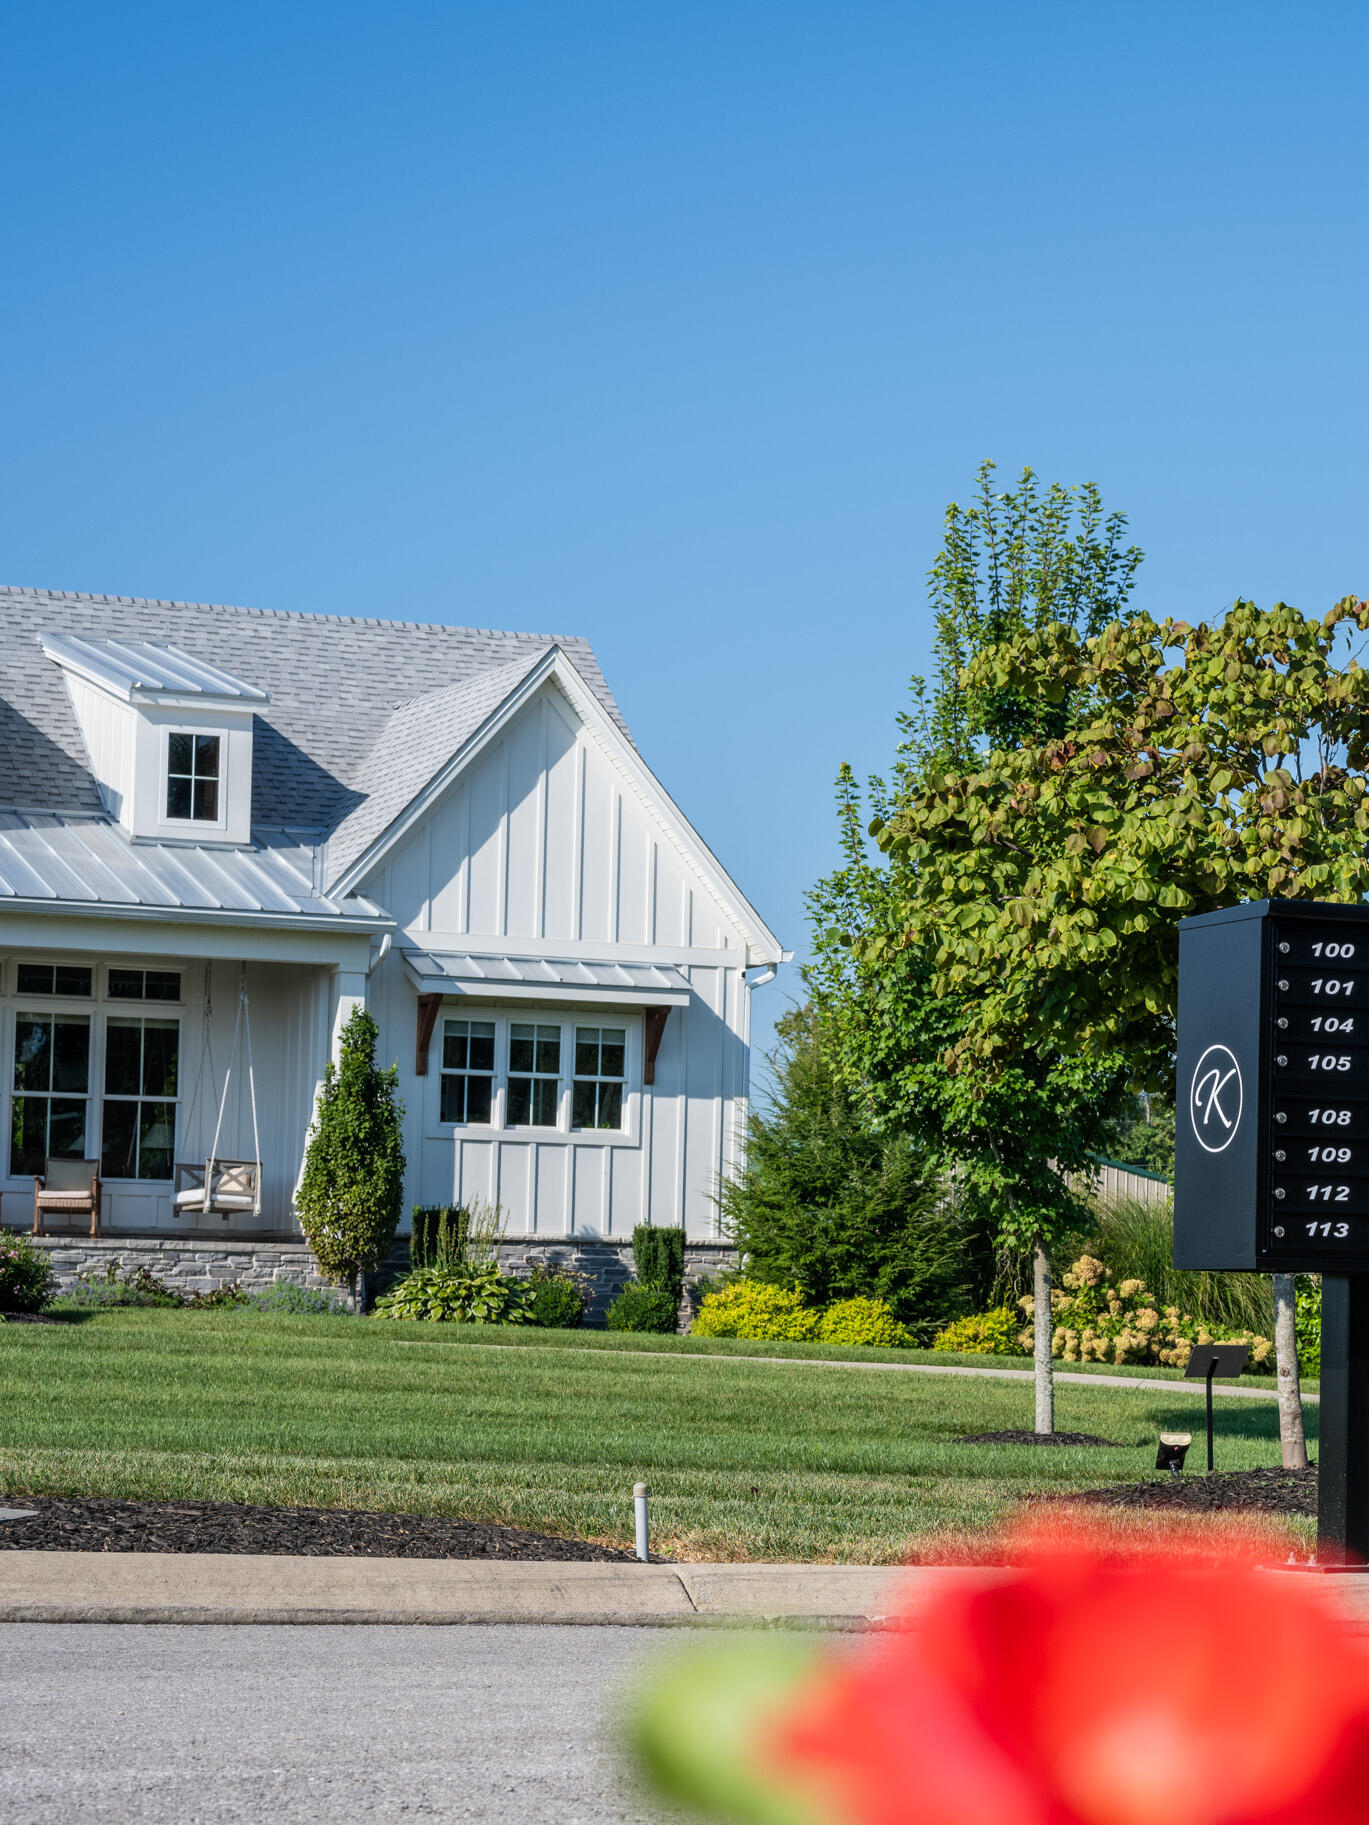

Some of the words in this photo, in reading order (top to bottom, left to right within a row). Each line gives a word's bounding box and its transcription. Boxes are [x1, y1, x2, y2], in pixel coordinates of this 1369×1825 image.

[1312, 943, 1355, 959] 100
[1311, 979, 1355, 996] 101
[1310, 1016, 1354, 1033] 104
[1308, 1054, 1351, 1071] 105
[1195, 1068, 1237, 1129] K
[1308, 1108, 1352, 1125] 108
[1307, 1146, 1351, 1163] 109
[1306, 1184, 1350, 1201] 112
[1305, 1221, 1350, 1238] 113
